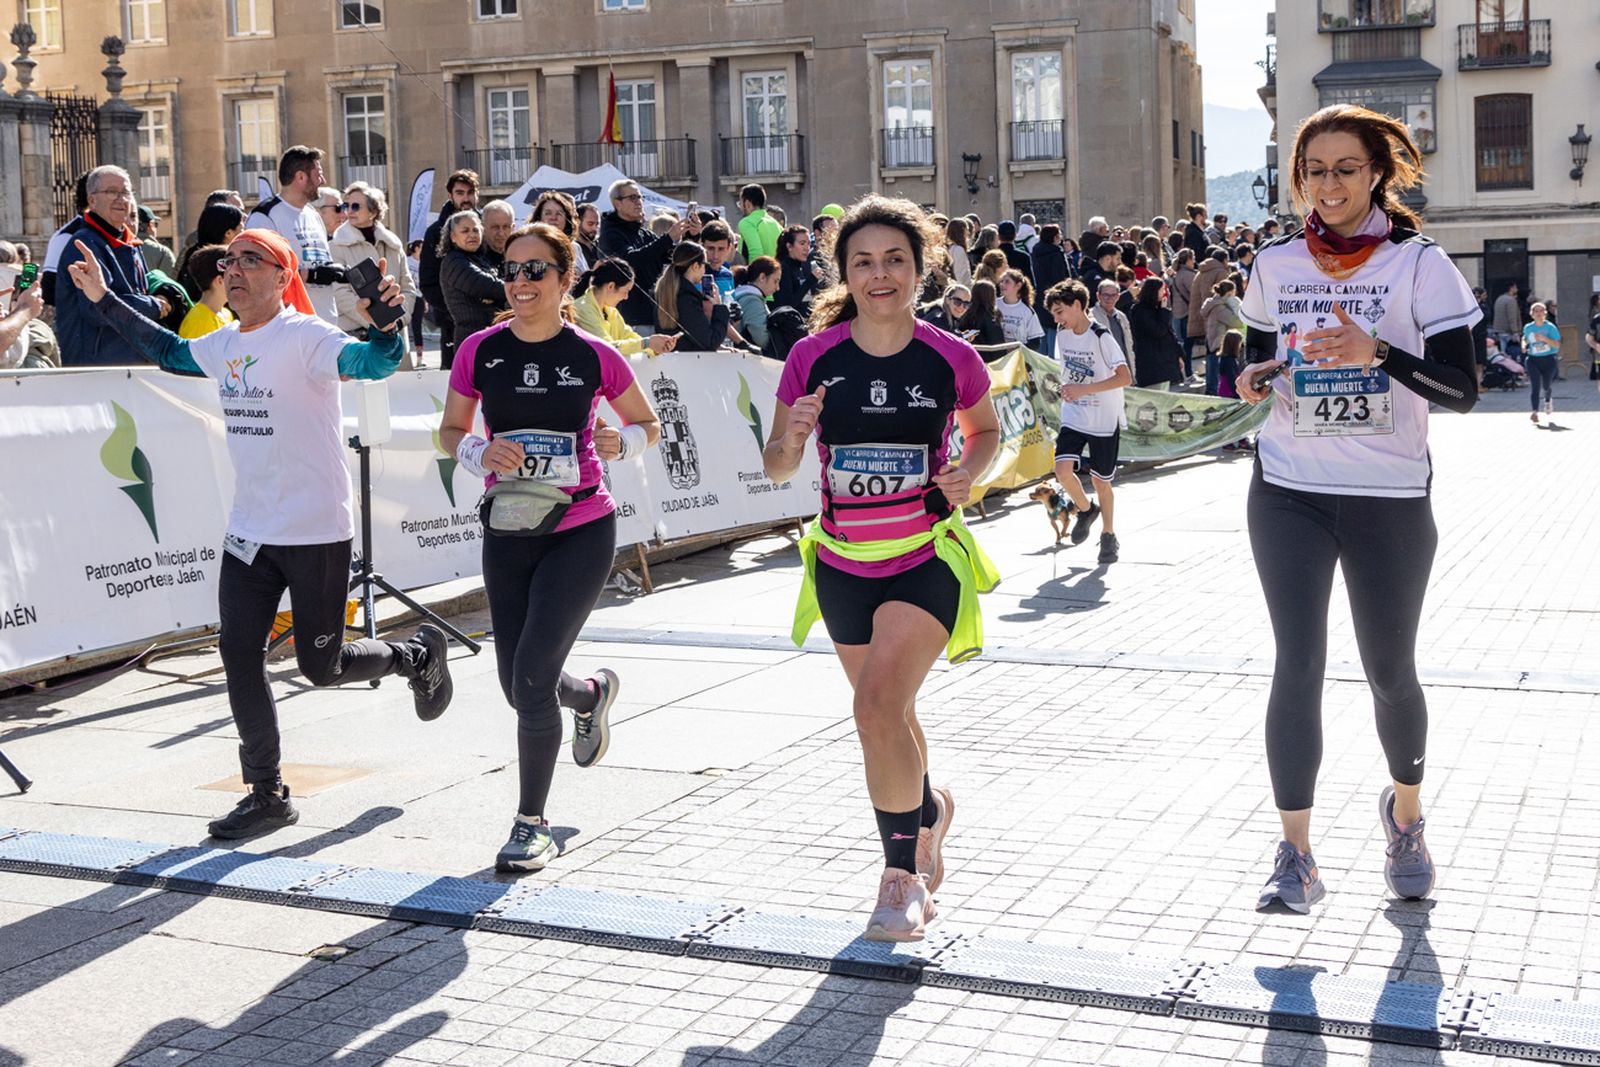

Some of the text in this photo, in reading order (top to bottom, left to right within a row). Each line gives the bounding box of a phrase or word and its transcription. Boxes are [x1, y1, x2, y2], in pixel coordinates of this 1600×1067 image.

[1287, 285, 1332, 295] CARRERA
[1334, 285, 1389, 295] CAMINATA
[1278, 299, 1363, 315] BUENA MURTE
[1312, 371, 1342, 380] CARRERA
[1343, 370, 1379, 380] CAMIATA
[1304, 381, 1364, 394] BUENA MUERTE
[1314, 394, 1371, 423] 423
[852, 450, 879, 458] CARRERA
[880, 450, 914, 458] CAMINATA
[842, 459, 898, 472] BUENA MUERTE
[848, 474, 905, 497] 607
[616, 502, 636, 518] AÉN
[661, 497, 691, 513] CIUDAD
[401, 511, 481, 534] Patronato Munici
[417, 532, 461, 549] Deportes
[462, 528, 475, 541] de
[85, 557, 152, 582] Patronato
[200, 546, 216, 561] de
[177, 567, 205, 585] Jaén
